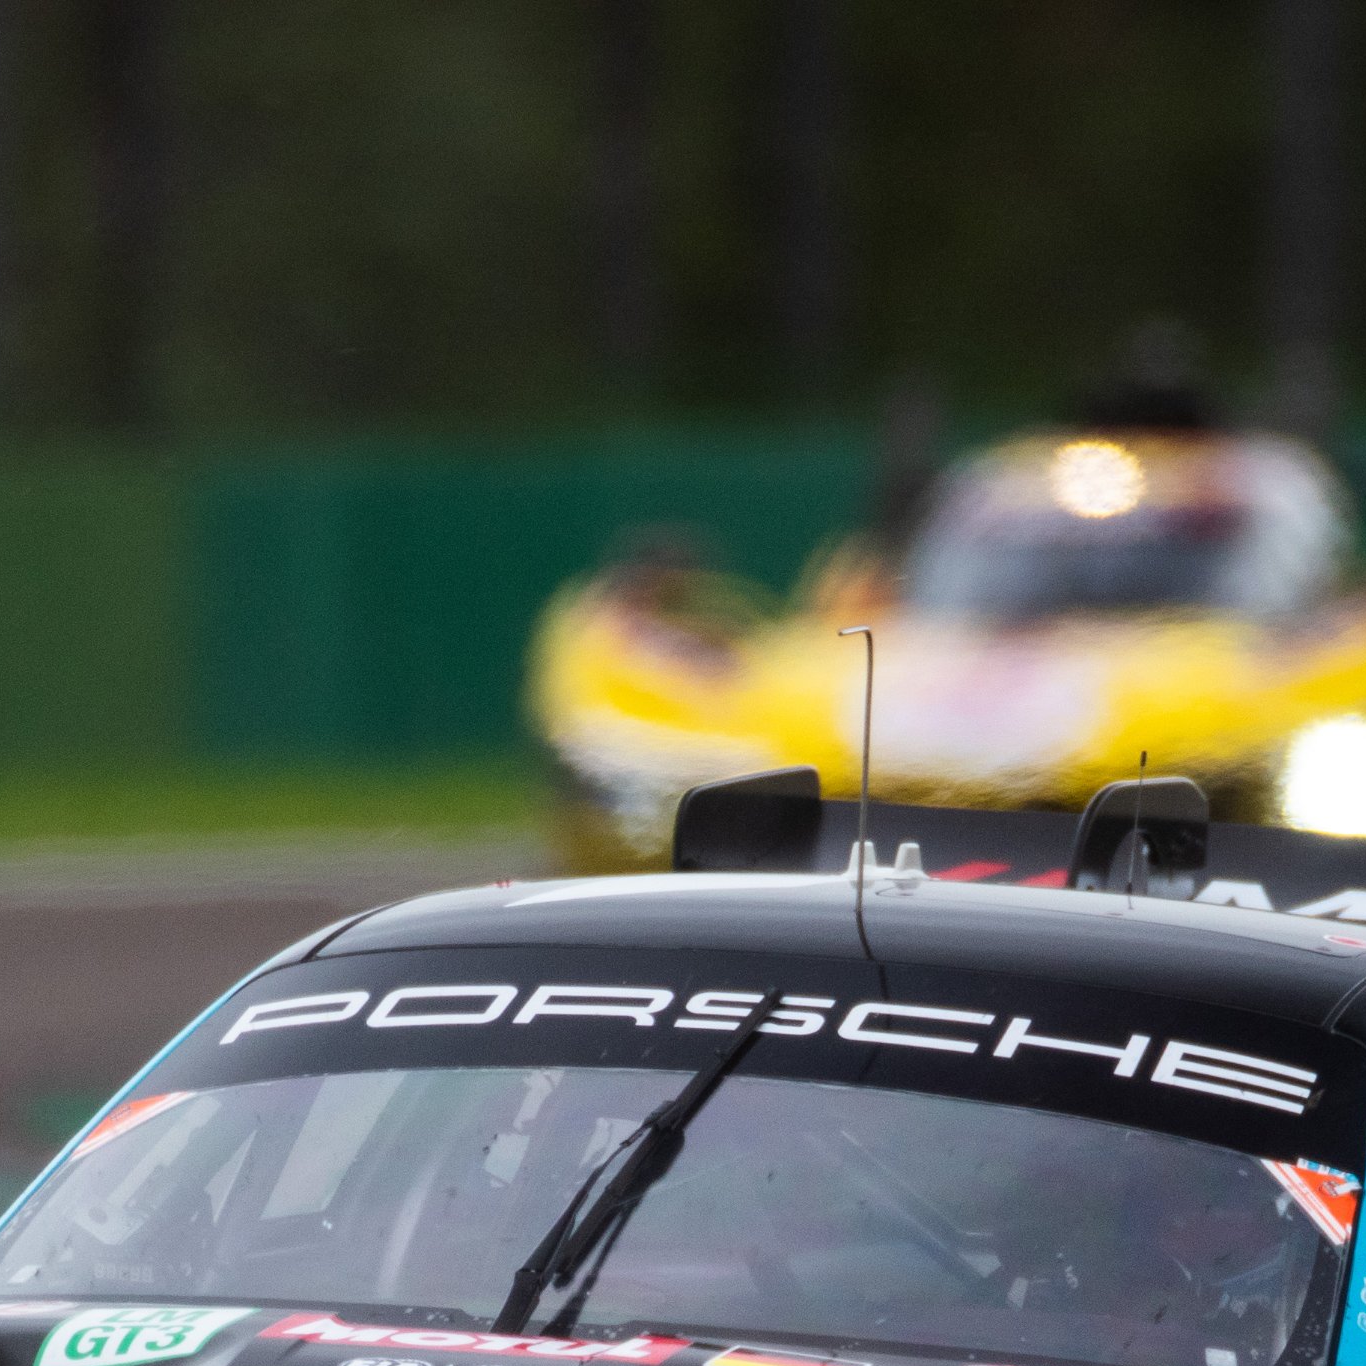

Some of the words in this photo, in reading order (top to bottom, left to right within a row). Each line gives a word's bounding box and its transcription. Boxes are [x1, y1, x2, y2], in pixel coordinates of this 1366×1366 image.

[219, 984, 1319, 1115] PORSCHE
[64, 1324, 196, 1363] GT3
[281, 1317, 653, 1359] MOTUL
